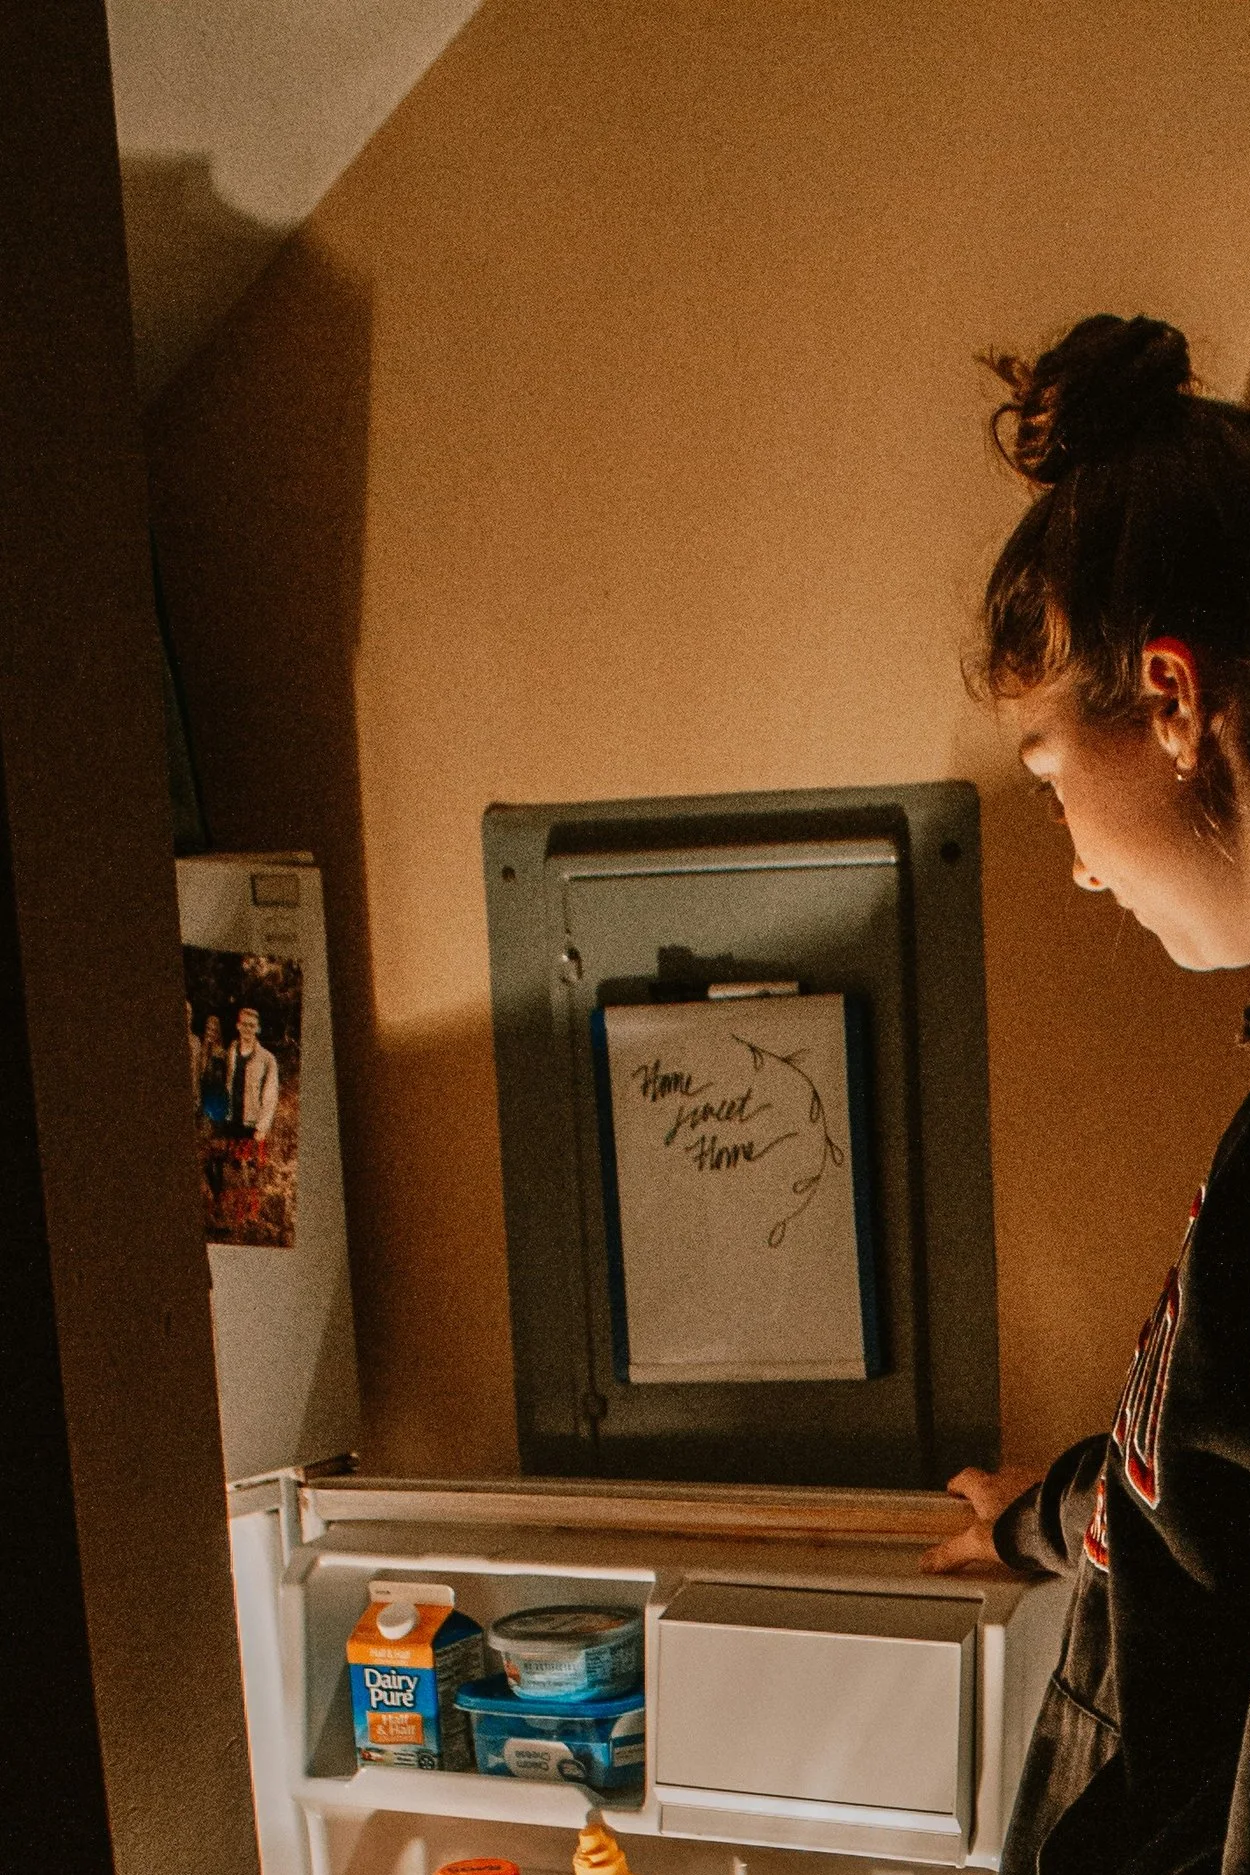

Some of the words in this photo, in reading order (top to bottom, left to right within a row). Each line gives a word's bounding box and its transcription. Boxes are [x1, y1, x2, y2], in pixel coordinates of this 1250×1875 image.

[631, 1058, 714, 1103] Home
[684, 1131, 799, 1171] Home
[363, 1667, 419, 1691] Dairy
[370, 1686, 415, 1709] Pure
